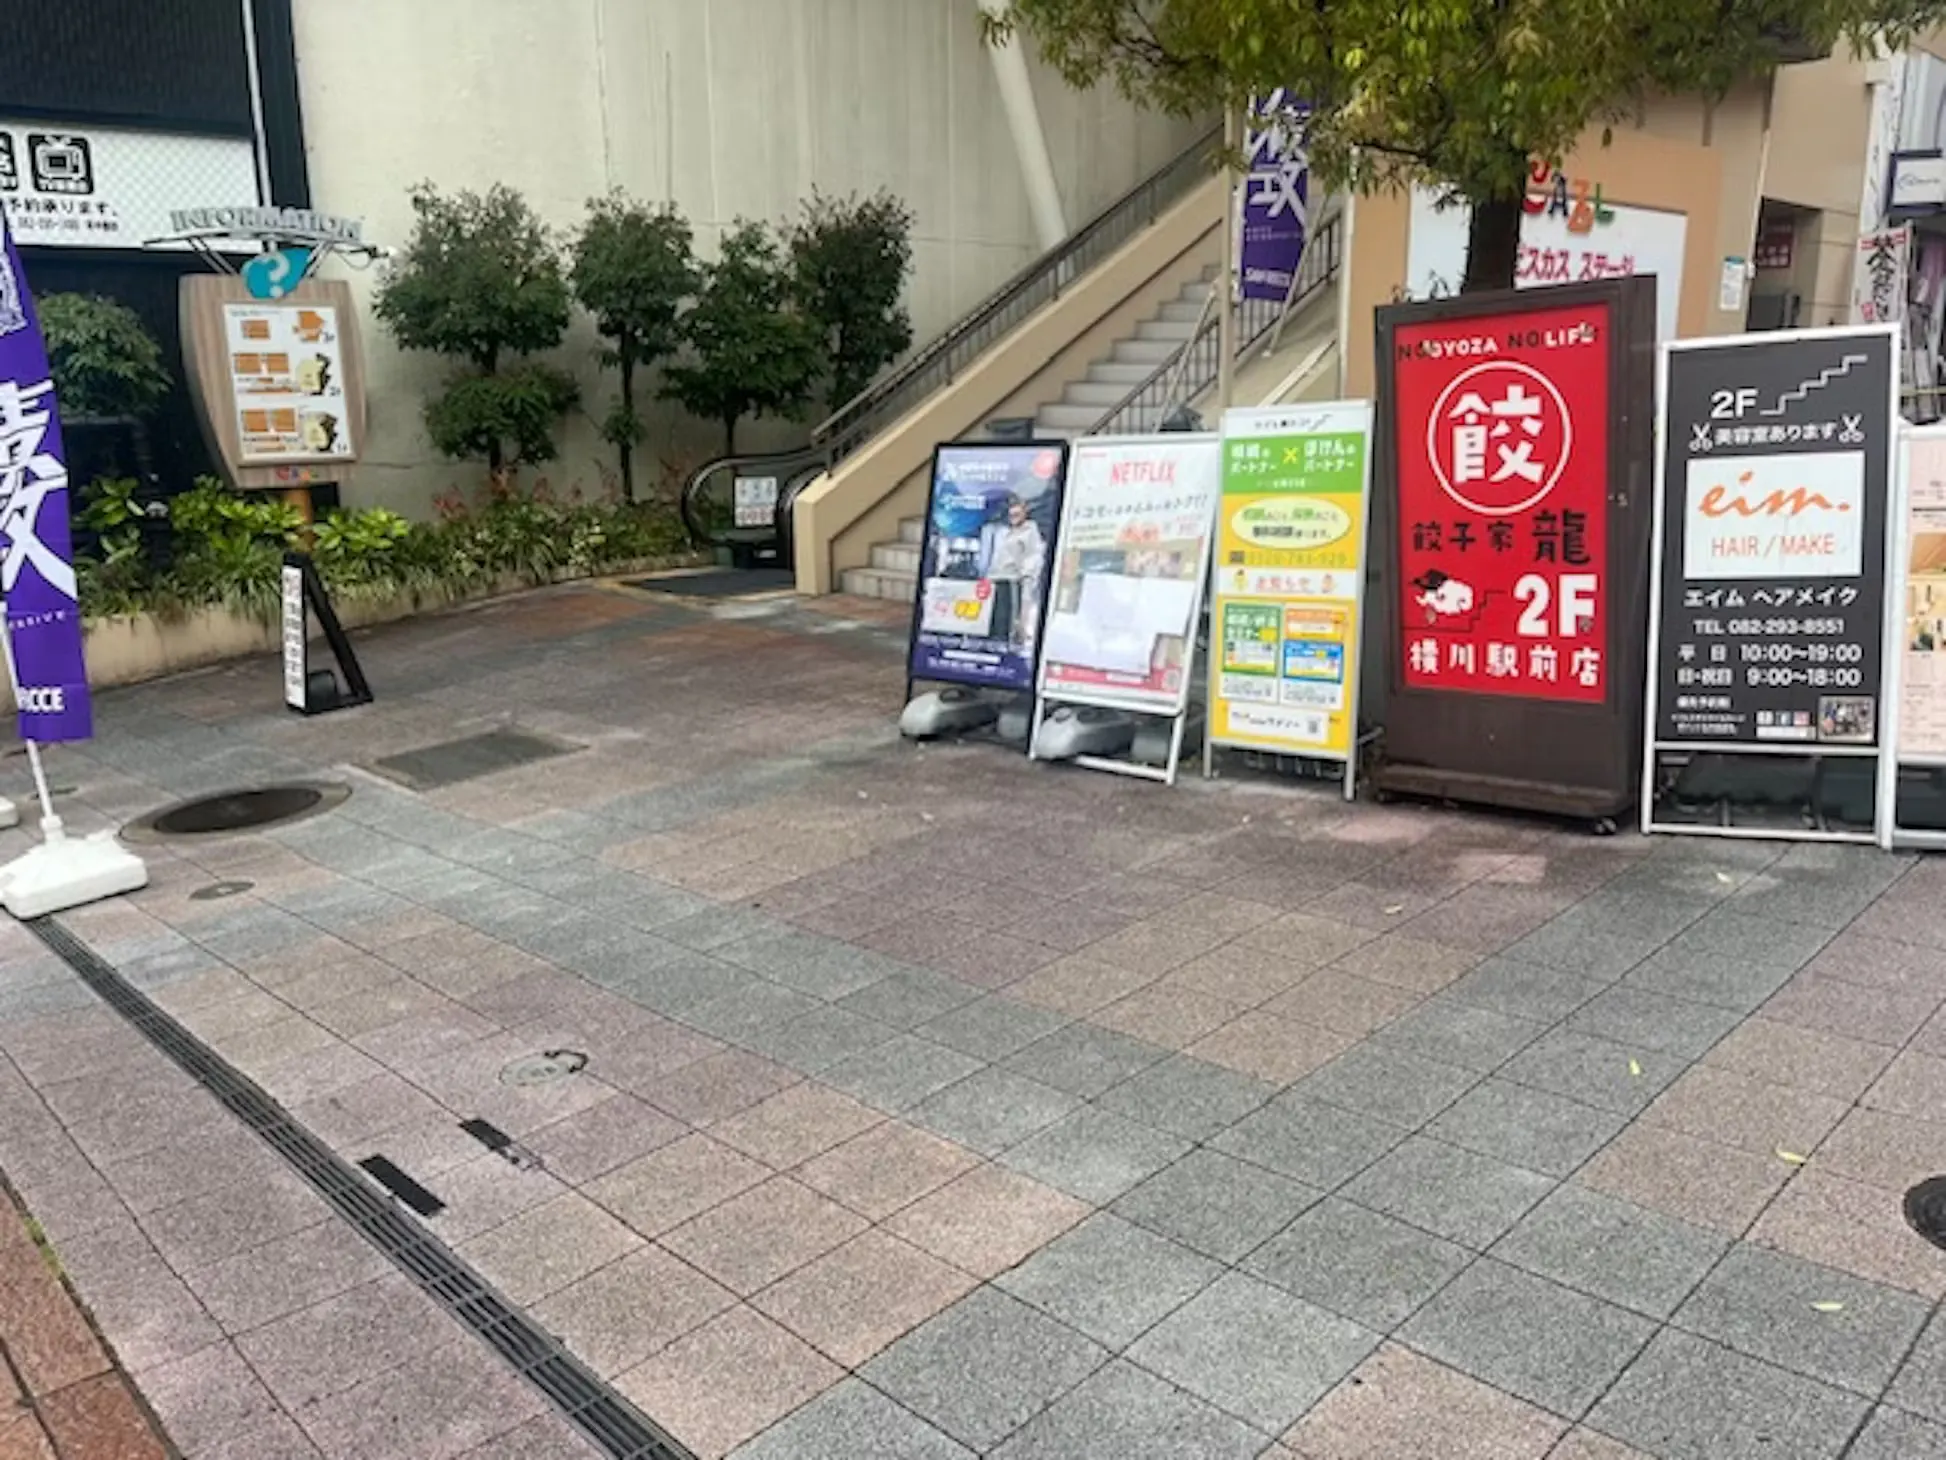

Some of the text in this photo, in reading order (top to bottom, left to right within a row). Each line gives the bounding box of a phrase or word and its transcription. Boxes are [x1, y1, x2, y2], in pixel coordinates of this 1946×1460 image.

[171, 207, 362, 241] INFORMATION
[1711, 388, 1759, 418] 2F
[1449, 385, 1544, 484] 餃
[1715, 423, 1838, 447] 美容室あります
[1110, 461, 1177, 485] NETFLIX
[1532, 508, 1592, 566] 龍
[1711, 536, 1759, 557] HAIR
[1781, 534, 1836, 556] MAKE
[1513, 573, 1599, 638] 2F
[1684, 586, 1859, 608] エイム ヘアメイク
[1693, 618, 1845, 635] TEL 082-293-8551
[1410, 637, 1601, 687] 横川駅前店
